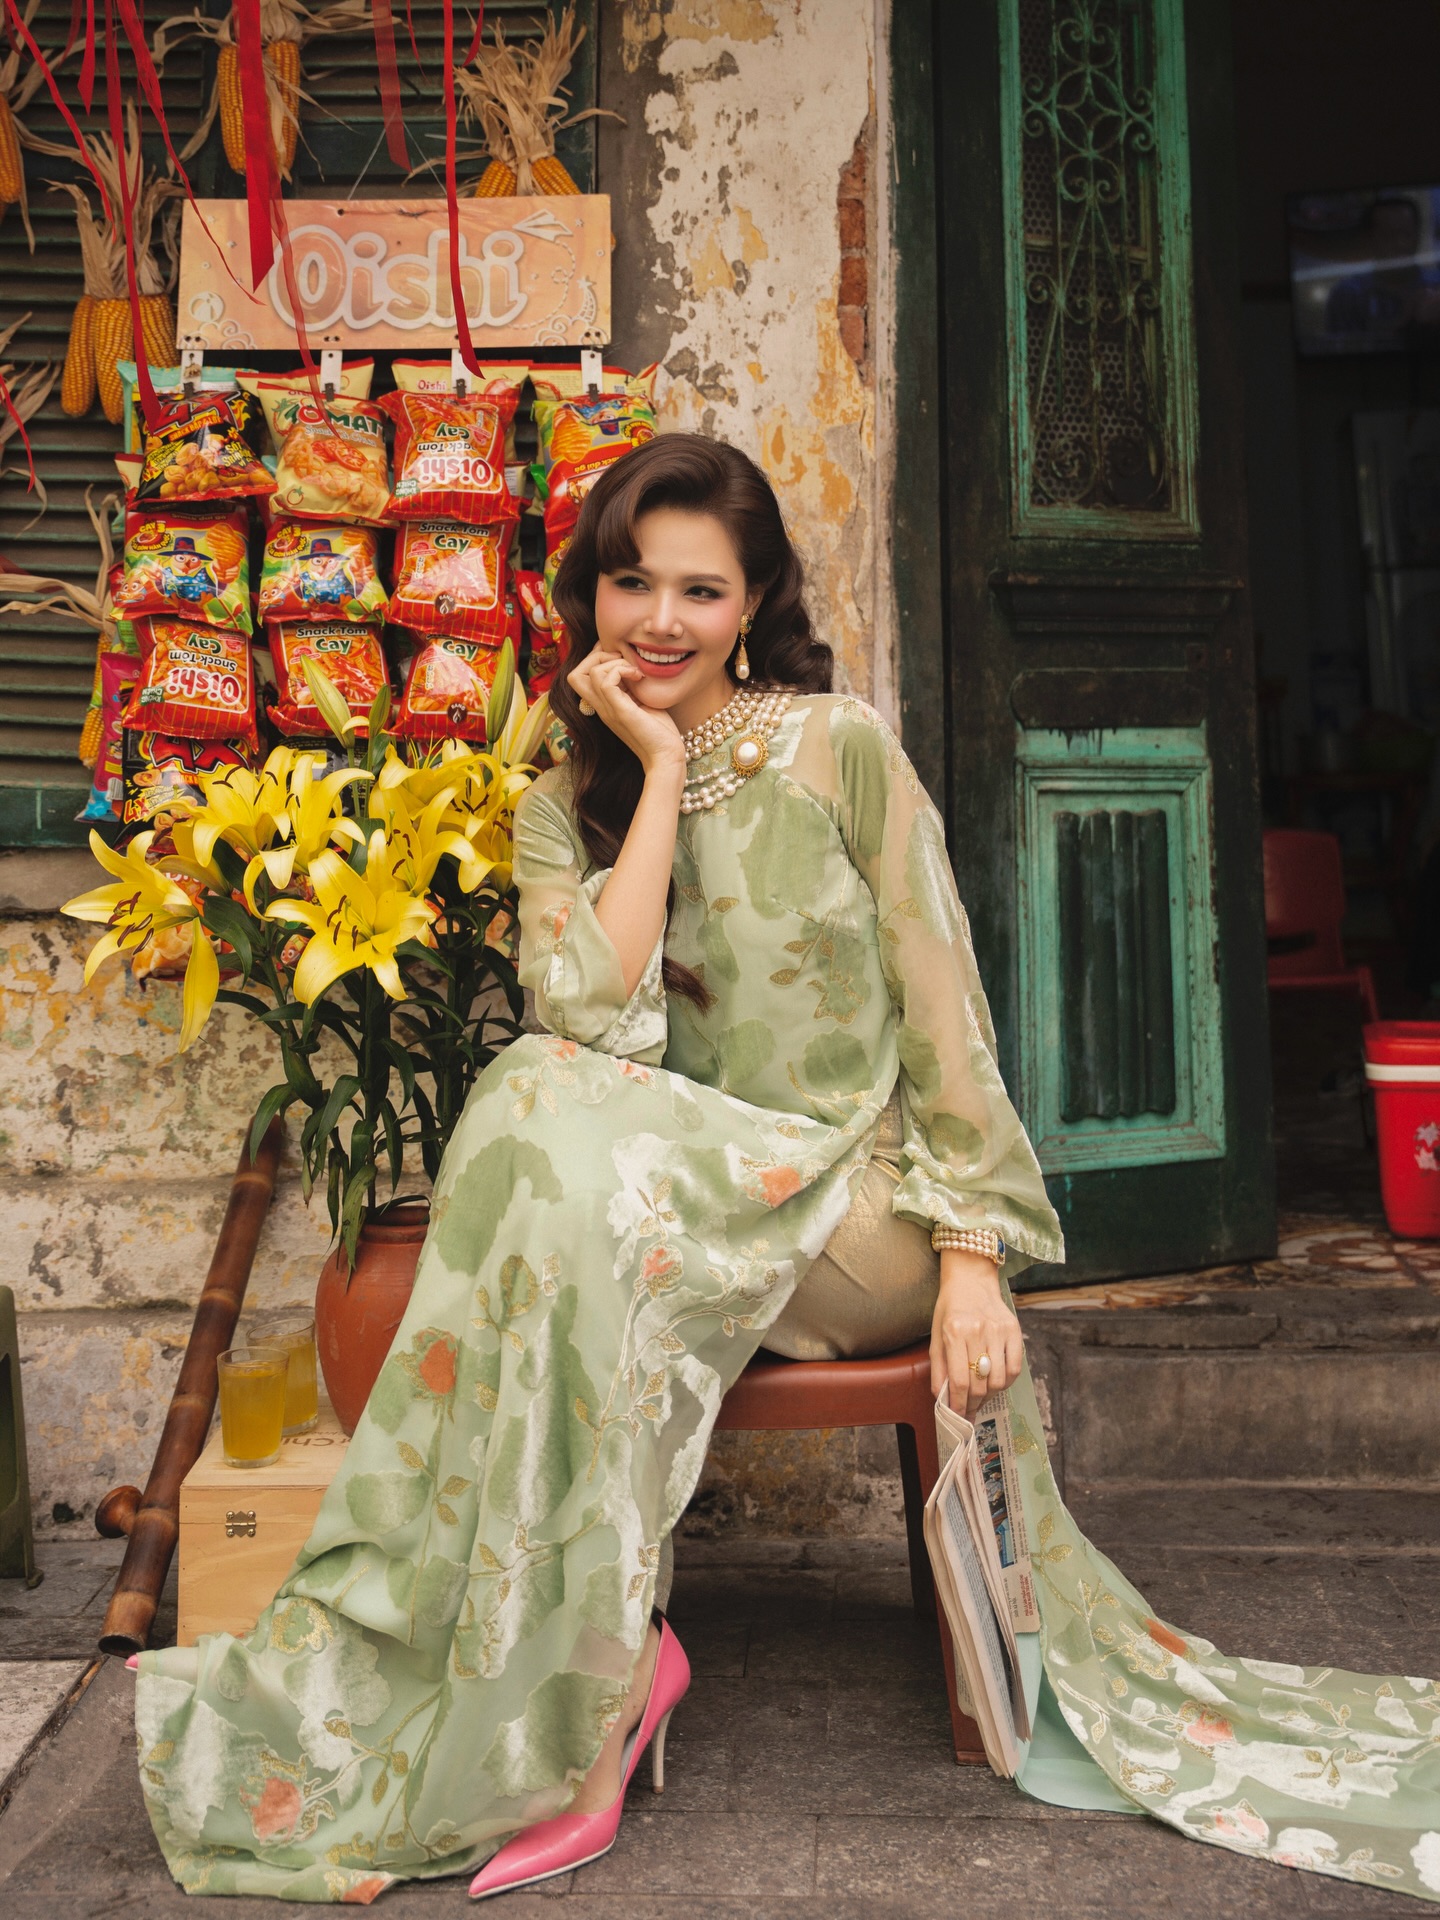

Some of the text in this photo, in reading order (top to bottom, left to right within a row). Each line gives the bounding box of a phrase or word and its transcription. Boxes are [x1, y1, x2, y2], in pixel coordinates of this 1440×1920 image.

[269, 224, 528, 331] Oishi
[418, 380, 446, 390] Oishi
[437, 423, 470, 440] Cay
[418, 443, 445, 452] Tôm
[420, 457, 493, 488] Oishi
[140, 522, 156, 533] CAY
[277, 525, 292, 539] CAY
[420, 523, 489, 536] Snack Tôm
[434, 535, 470, 554] Cay
[297, 627, 367, 637] Snack Tôm
[188, 634, 221, 654] Cay
[315, 638, 351, 655] Cay
[442, 641, 478, 660] Cay
[169, 651, 237, 671] Snack Tôm
[167, 667, 240, 705] Oishi
